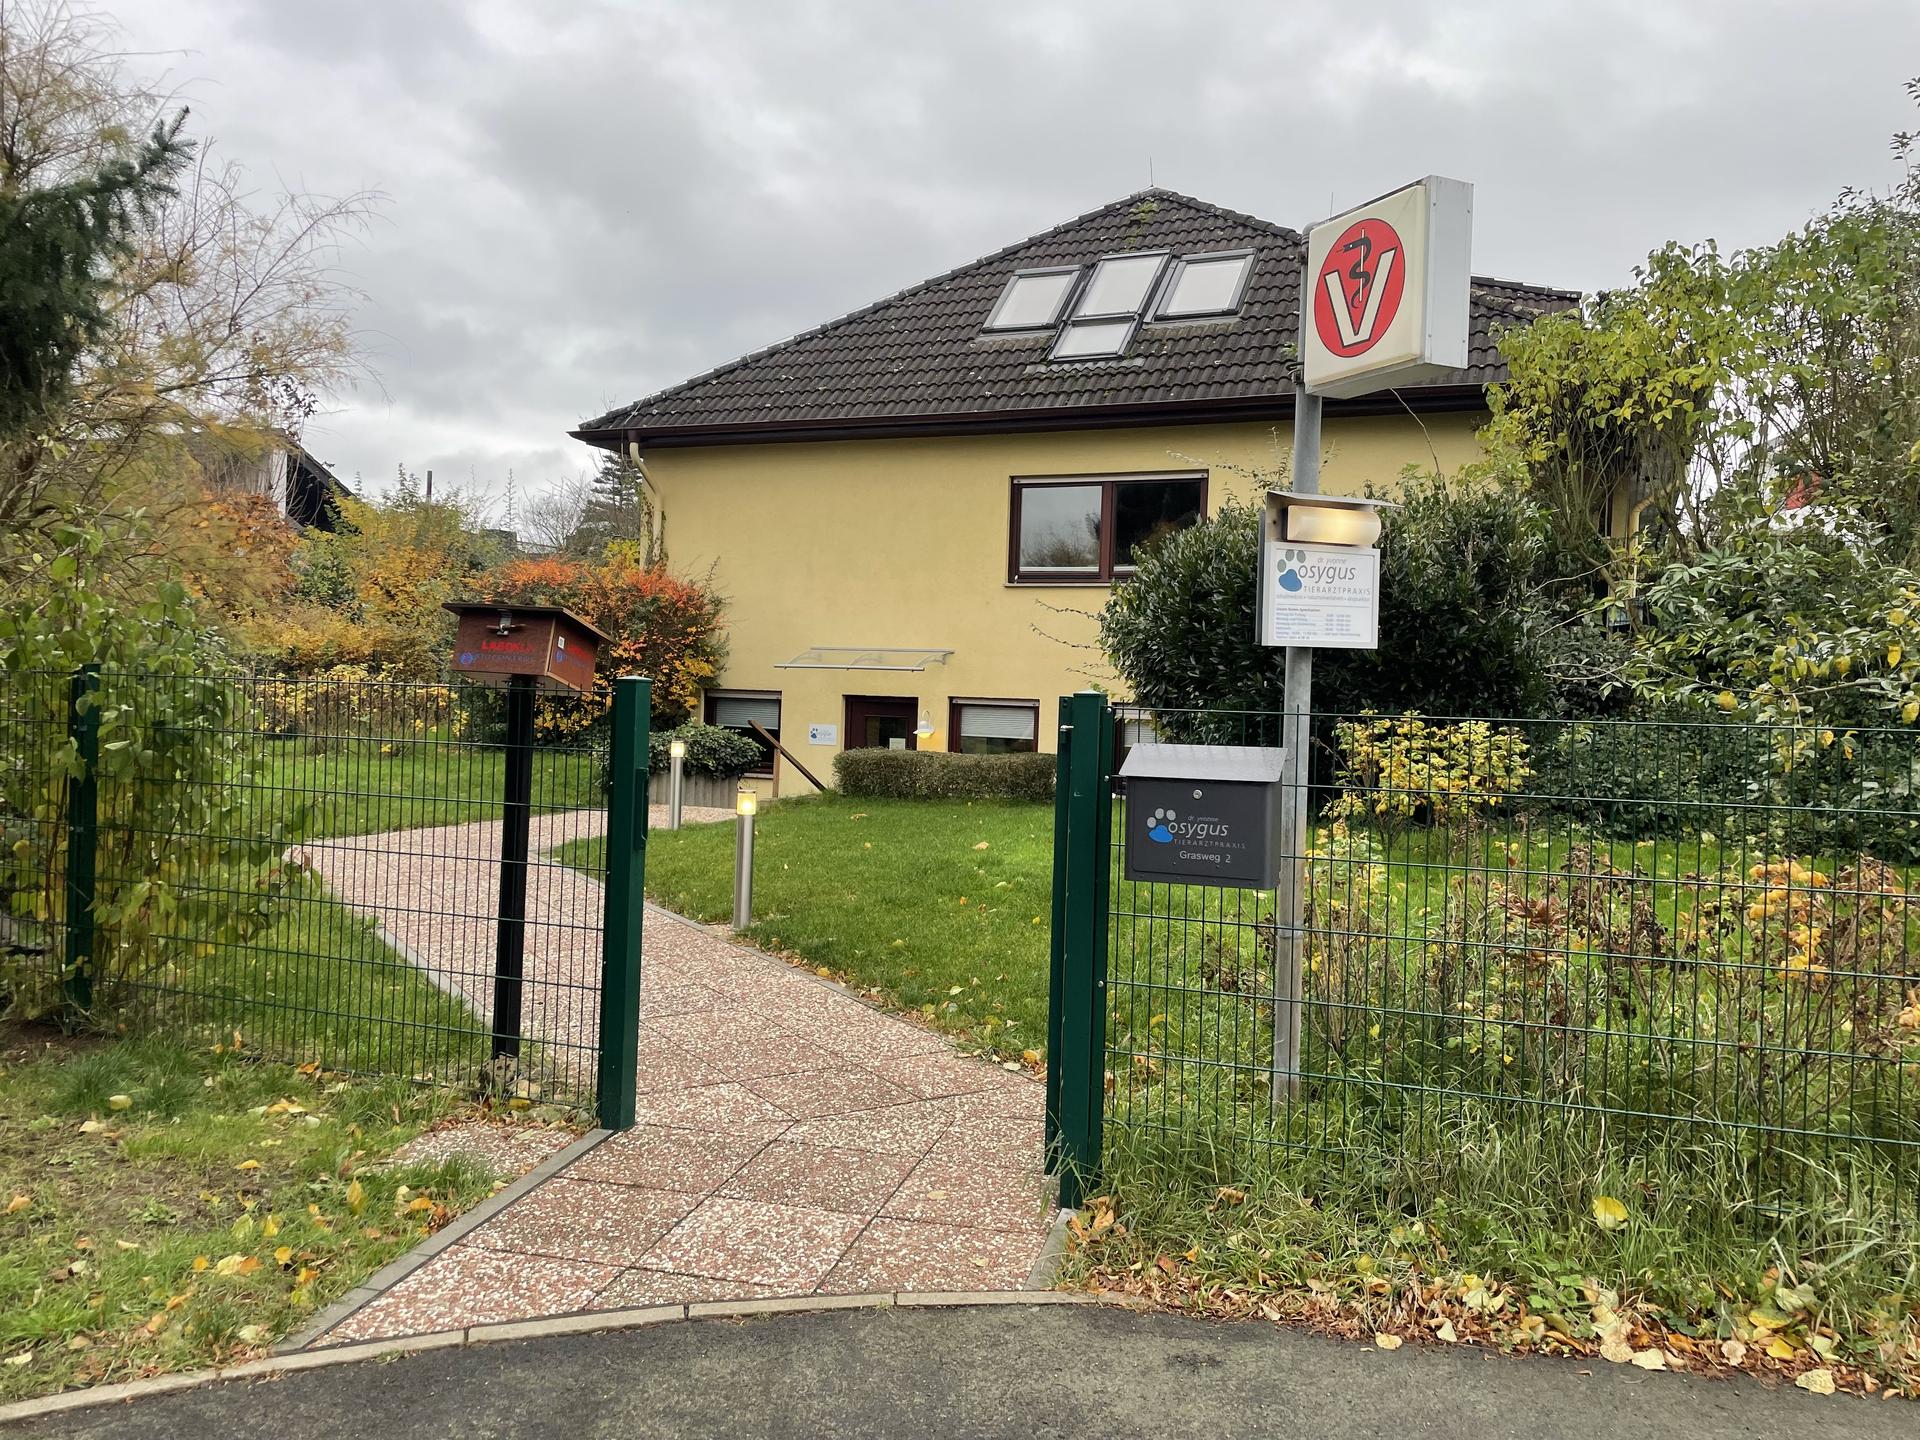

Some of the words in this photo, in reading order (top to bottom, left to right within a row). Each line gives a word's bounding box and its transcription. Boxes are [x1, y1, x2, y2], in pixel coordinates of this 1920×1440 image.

[1324, 247, 1398, 348] V
[1298, 565, 1356, 584] osygus
[1304, 586, 1371, 595] TIERARZTPRAXIS
[1168, 822, 1229, 839] osygus
[1174, 839, 1246, 849] TIERARZTPRAXIS
[1179, 850, 1221, 863] Grasweg
[1225, 854, 1231, 863] 2
